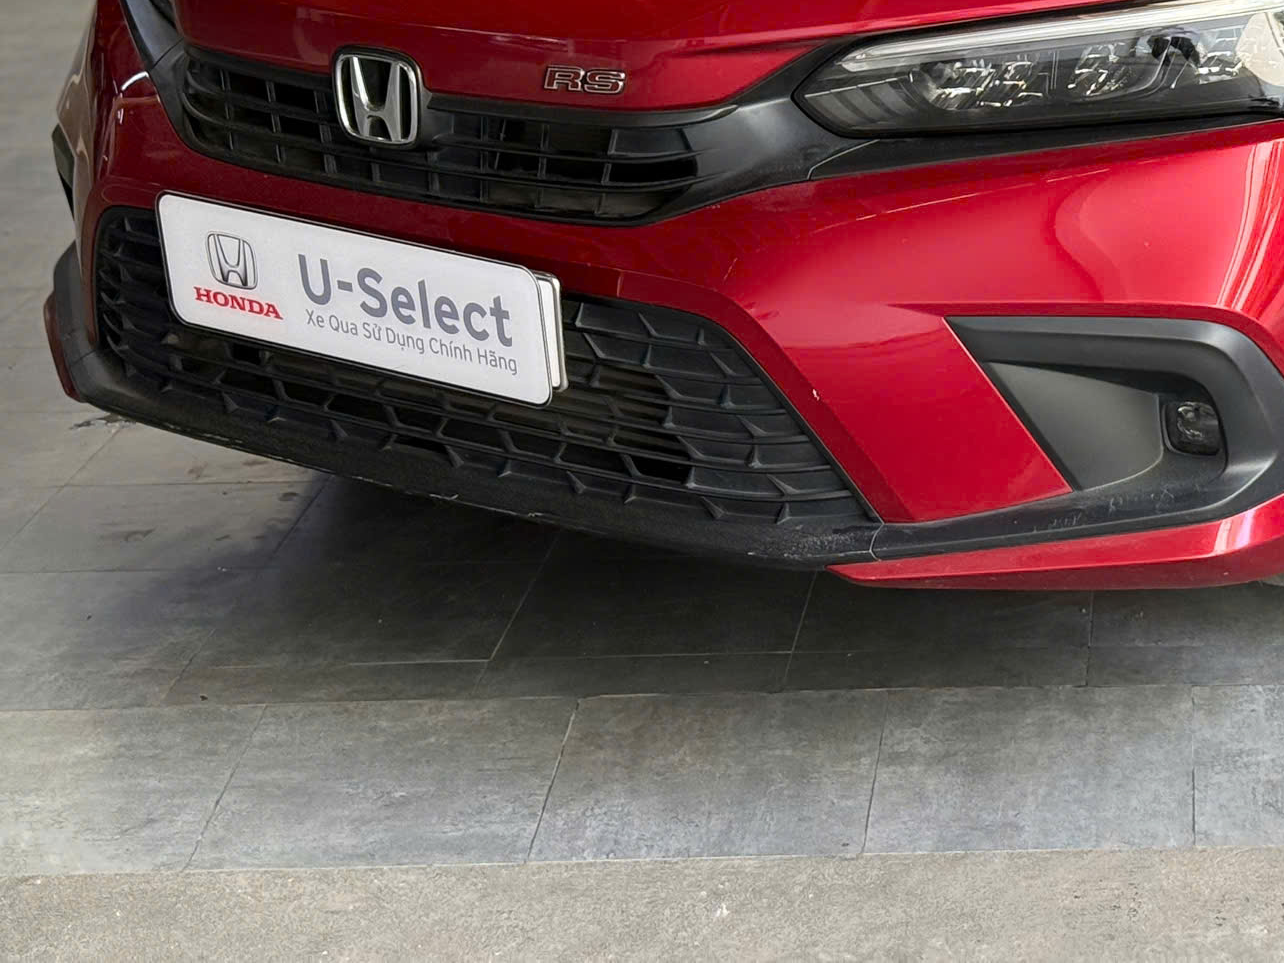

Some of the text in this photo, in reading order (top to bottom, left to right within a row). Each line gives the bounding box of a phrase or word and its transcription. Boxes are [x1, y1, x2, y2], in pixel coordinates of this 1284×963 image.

[544, 65, 625, 94] RS
[193, 286, 284, 320] HONDA
[298, 254, 513, 348] U-Select
[305, 308, 325, 328] Xe
[329, 314, 358, 336] Qua
[385, 327, 425, 355] Dụng
[429, 337, 473, 363] Chính
[477, 347, 518, 376] Hãng
